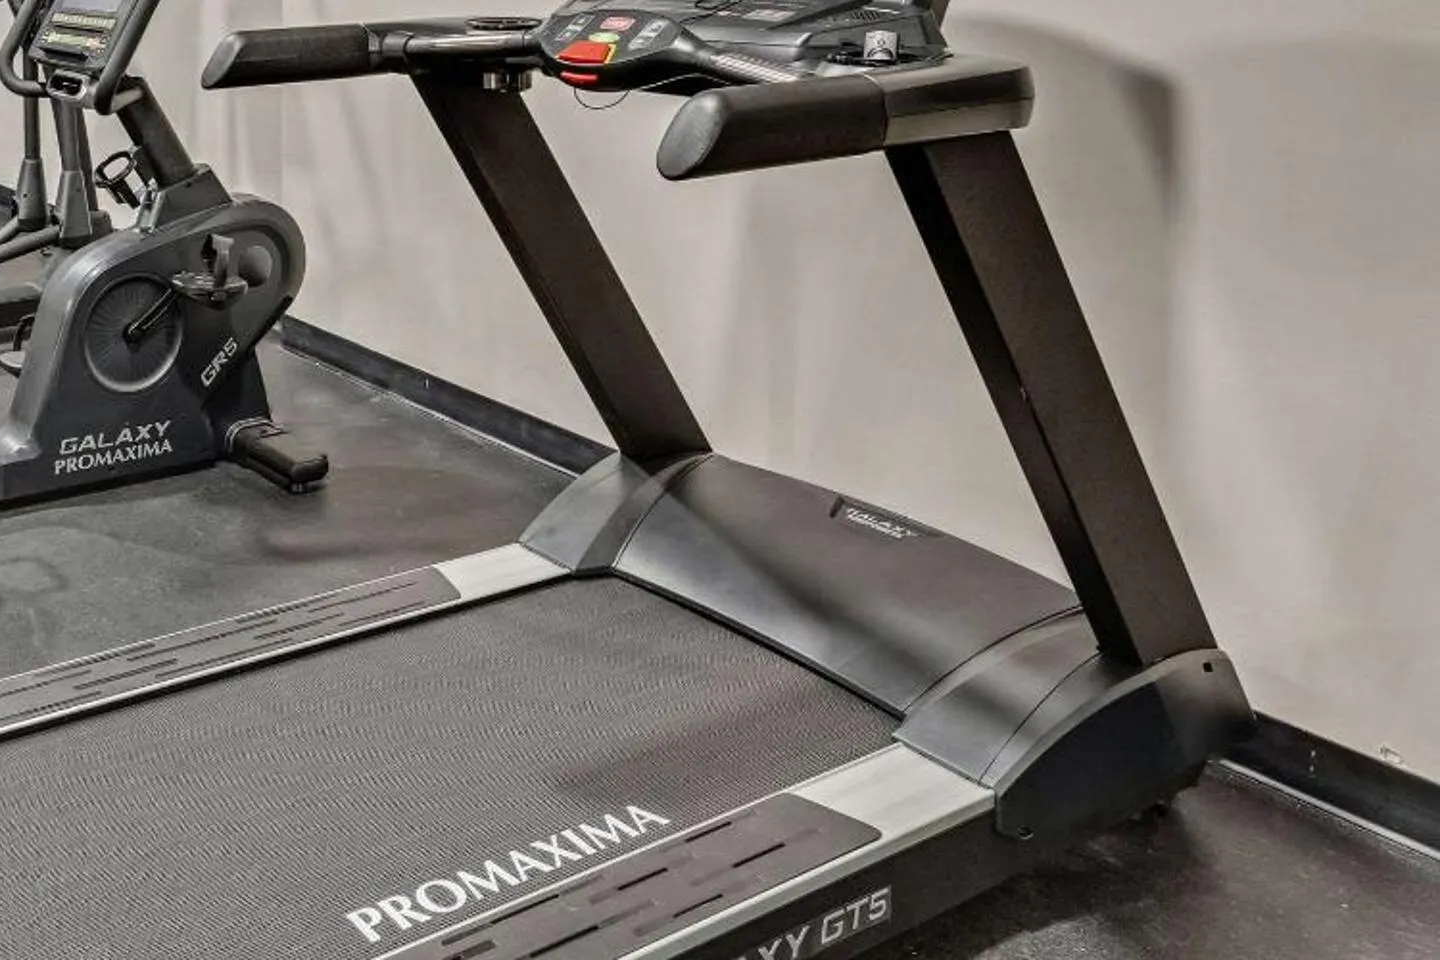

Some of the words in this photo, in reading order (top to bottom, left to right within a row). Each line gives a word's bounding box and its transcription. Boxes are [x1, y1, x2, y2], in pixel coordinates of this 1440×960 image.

[53, 439, 174, 476] PROMAXIMA
[59, 419, 172, 455] GALAXY
[346, 804, 672, 943] PROMAXIMA
[821, 887, 892, 944] GT5
